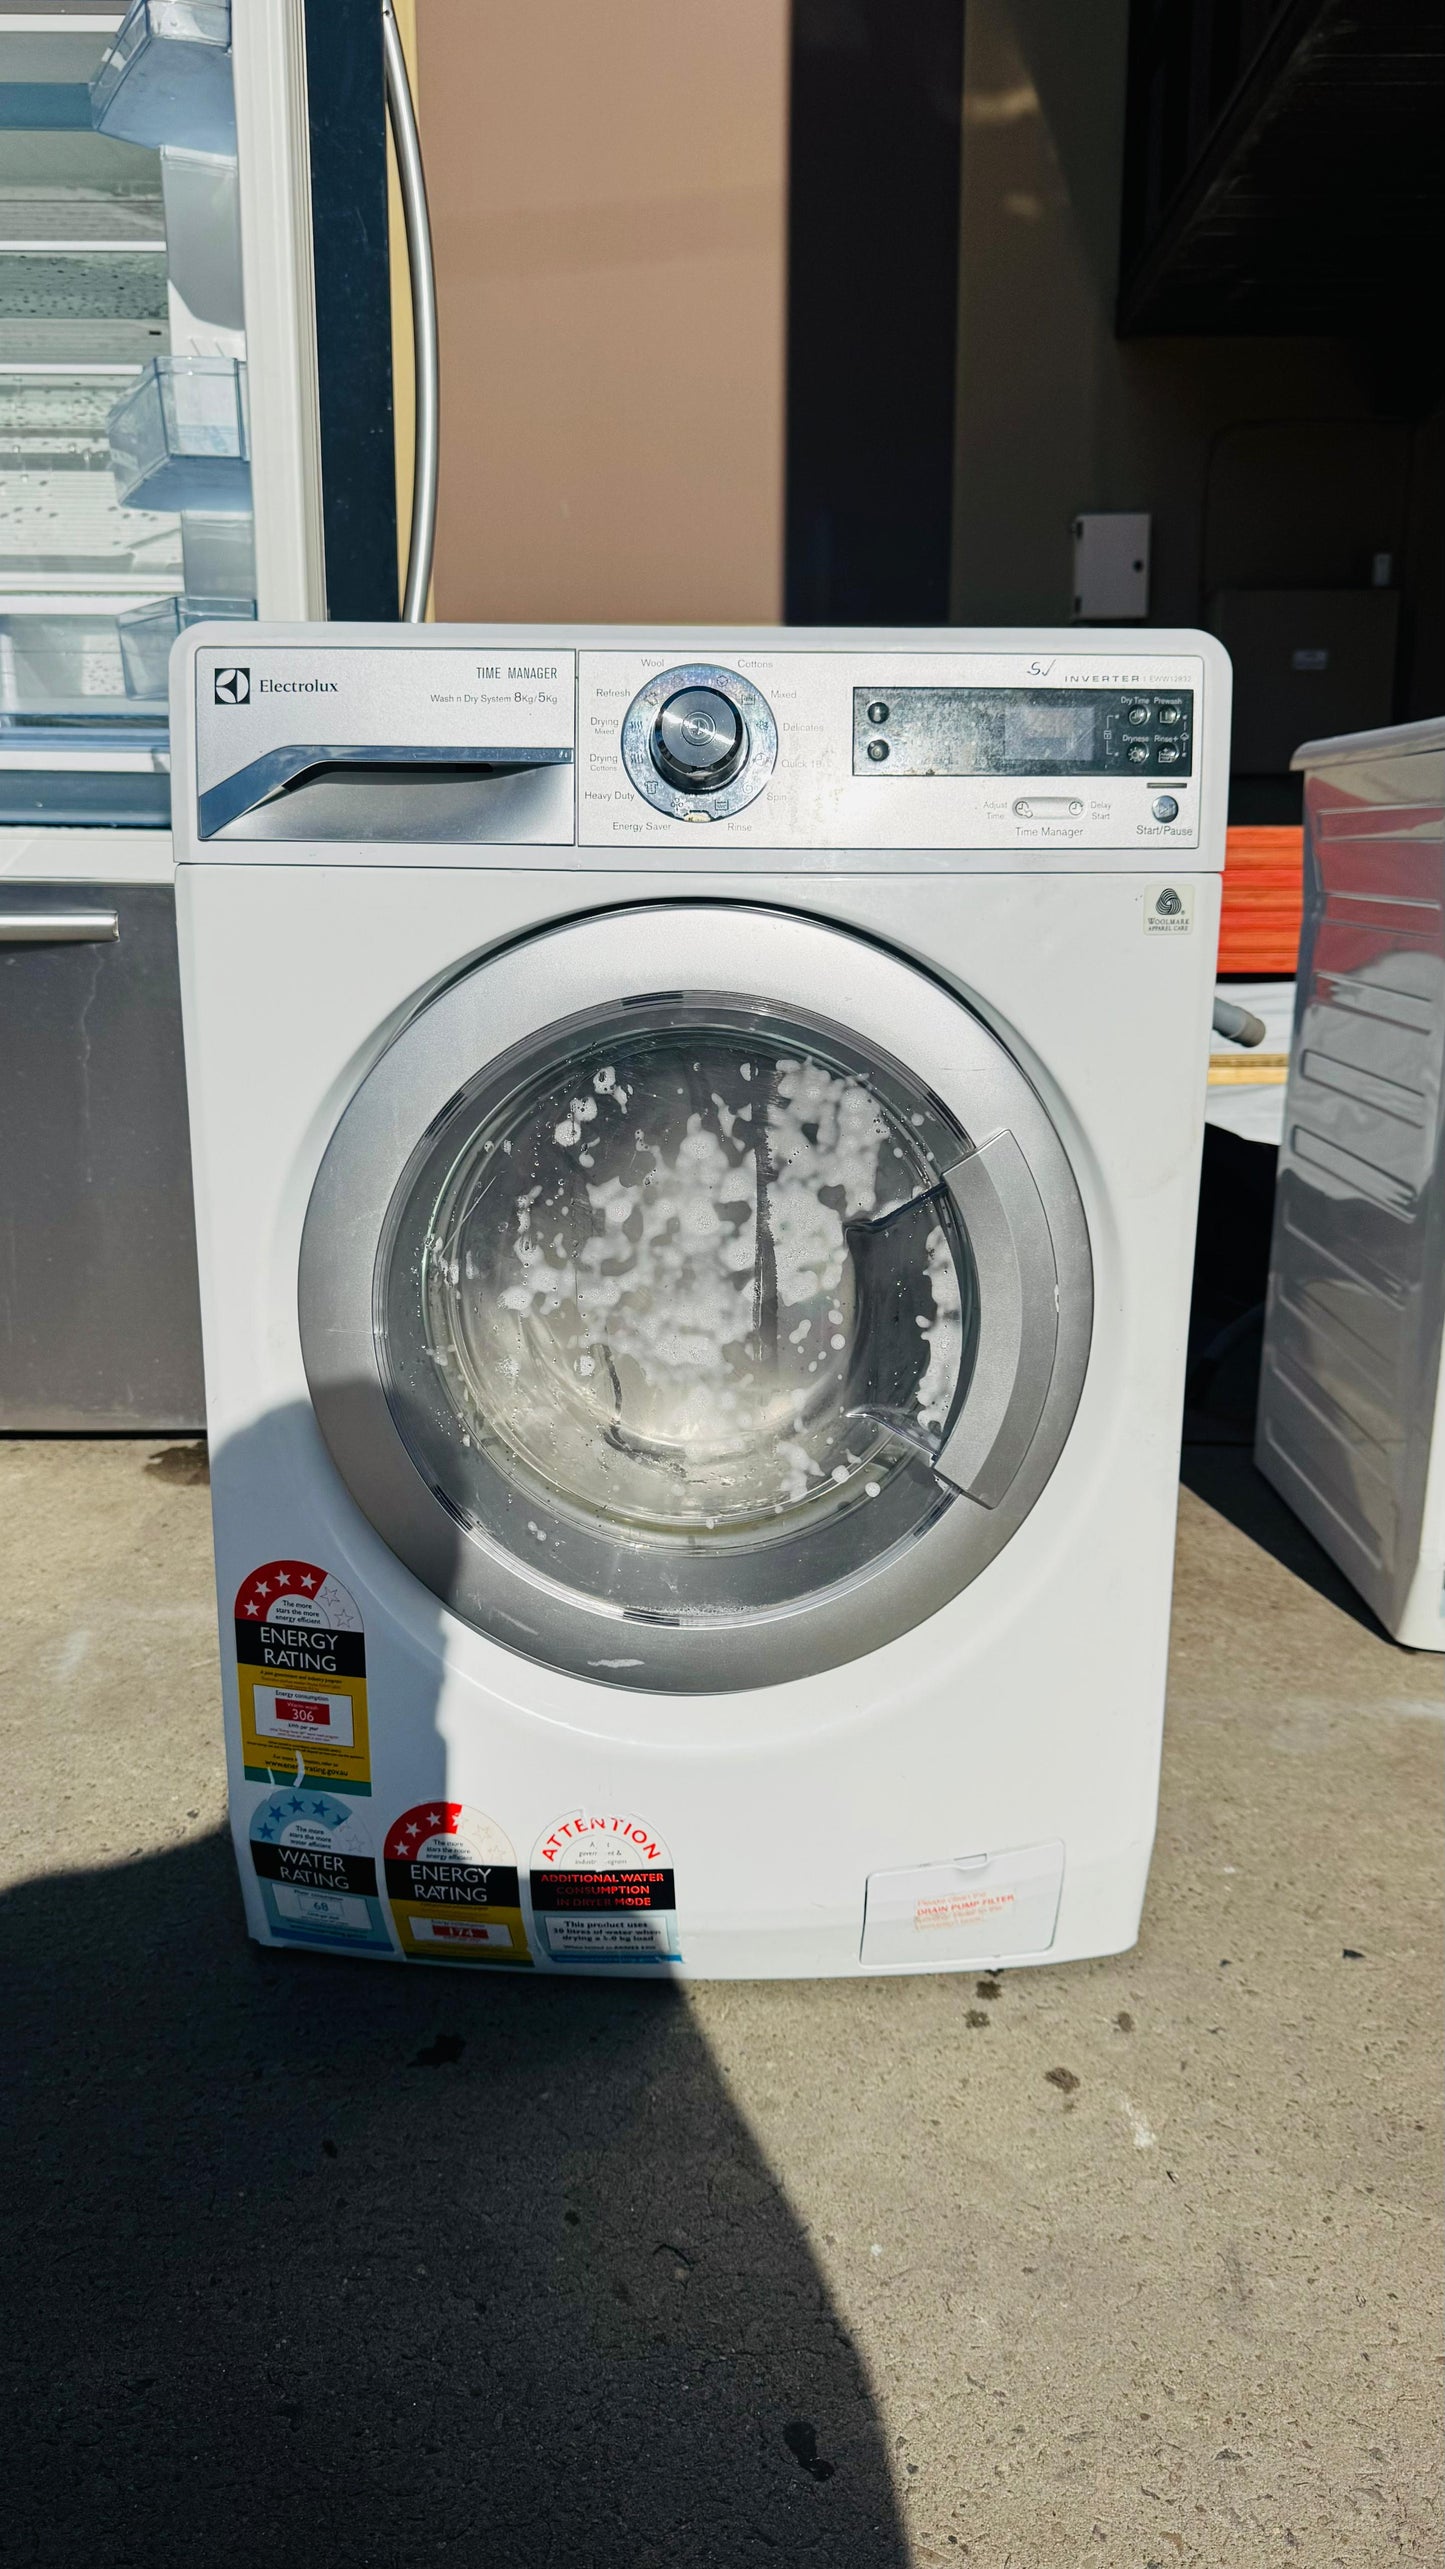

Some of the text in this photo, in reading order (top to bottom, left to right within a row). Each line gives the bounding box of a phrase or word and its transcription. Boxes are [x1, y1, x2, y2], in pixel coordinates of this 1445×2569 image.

[640, 658, 664, 668] Wool
[737, 659, 774, 669] Cottons
[476, 666, 558, 680] TIME MANAGER
[259, 678, 339, 694] Electrolux
[596, 688, 631, 698] Refresh
[770, 689, 797, 700] Mixed
[430, 694, 454, 703] Wash
[464, 694, 479, 705] Dry
[480, 694, 512, 705] System
[1120, 696, 1150, 706] Dry Time
[1153, 696, 1182, 705] Prewash
[590, 716, 619, 729] Drying
[782, 722, 824, 732] Delicates
[594, 727, 615, 736] Mixed
[589, 754, 618, 765] Drying
[781, 758, 808, 769] Quick
[590, 764, 618, 772] Cottons
[584, 791, 635, 802] Heavy Duty
[766, 792, 787, 802] Spin
[983, 800, 1008, 810] Adjust
[1090, 800, 1111, 810] Delay
[986, 812, 1004, 820] Time
[1091, 812, 1110, 820] Start
[612, 822, 672, 832] Energy Saver
[727, 822, 752, 832] Rinse
[1015, 826, 1084, 838] Time Manager
[1136, 824, 1193, 836] Start/Pause
[282, 1599, 312, 1610] The more
[275, 1607, 320, 1618] stars the more
[275, 1615, 321, 1625] energy efficient
[260, 1626, 339, 1651] ENERGY
[264, 1649, 337, 1672] RATING
[275, 1689, 329, 1702] Energy consumption
[291, 1708, 315, 1722] 306
[296, 1824, 307, 1833] The
[542, 1817, 661, 1862] ATTENTION
[278, 1848, 346, 1872] WATER
[280, 1866, 350, 1890] RATING
[410, 1864, 492, 1884] ENERGY
[541, 1873, 664, 1883] ADDITIONAL WATER
[414, 1884, 488, 1902] RATING
[556, 1885, 650, 1895] CONSUMPTION
[557, 1898, 570, 1906] IN
[614, 1897, 651, 1906] MODE
[917, 1905, 948, 1916] DRAIN
[950, 1900, 980, 1911] PUMP
[982, 1893, 1015, 1906] FILTER
[313, 1902, 329, 1912] 68
[564, 1920, 585, 1928] This
[586, 1921, 625, 1930] product
[562, 1934, 593, 1942] drying
